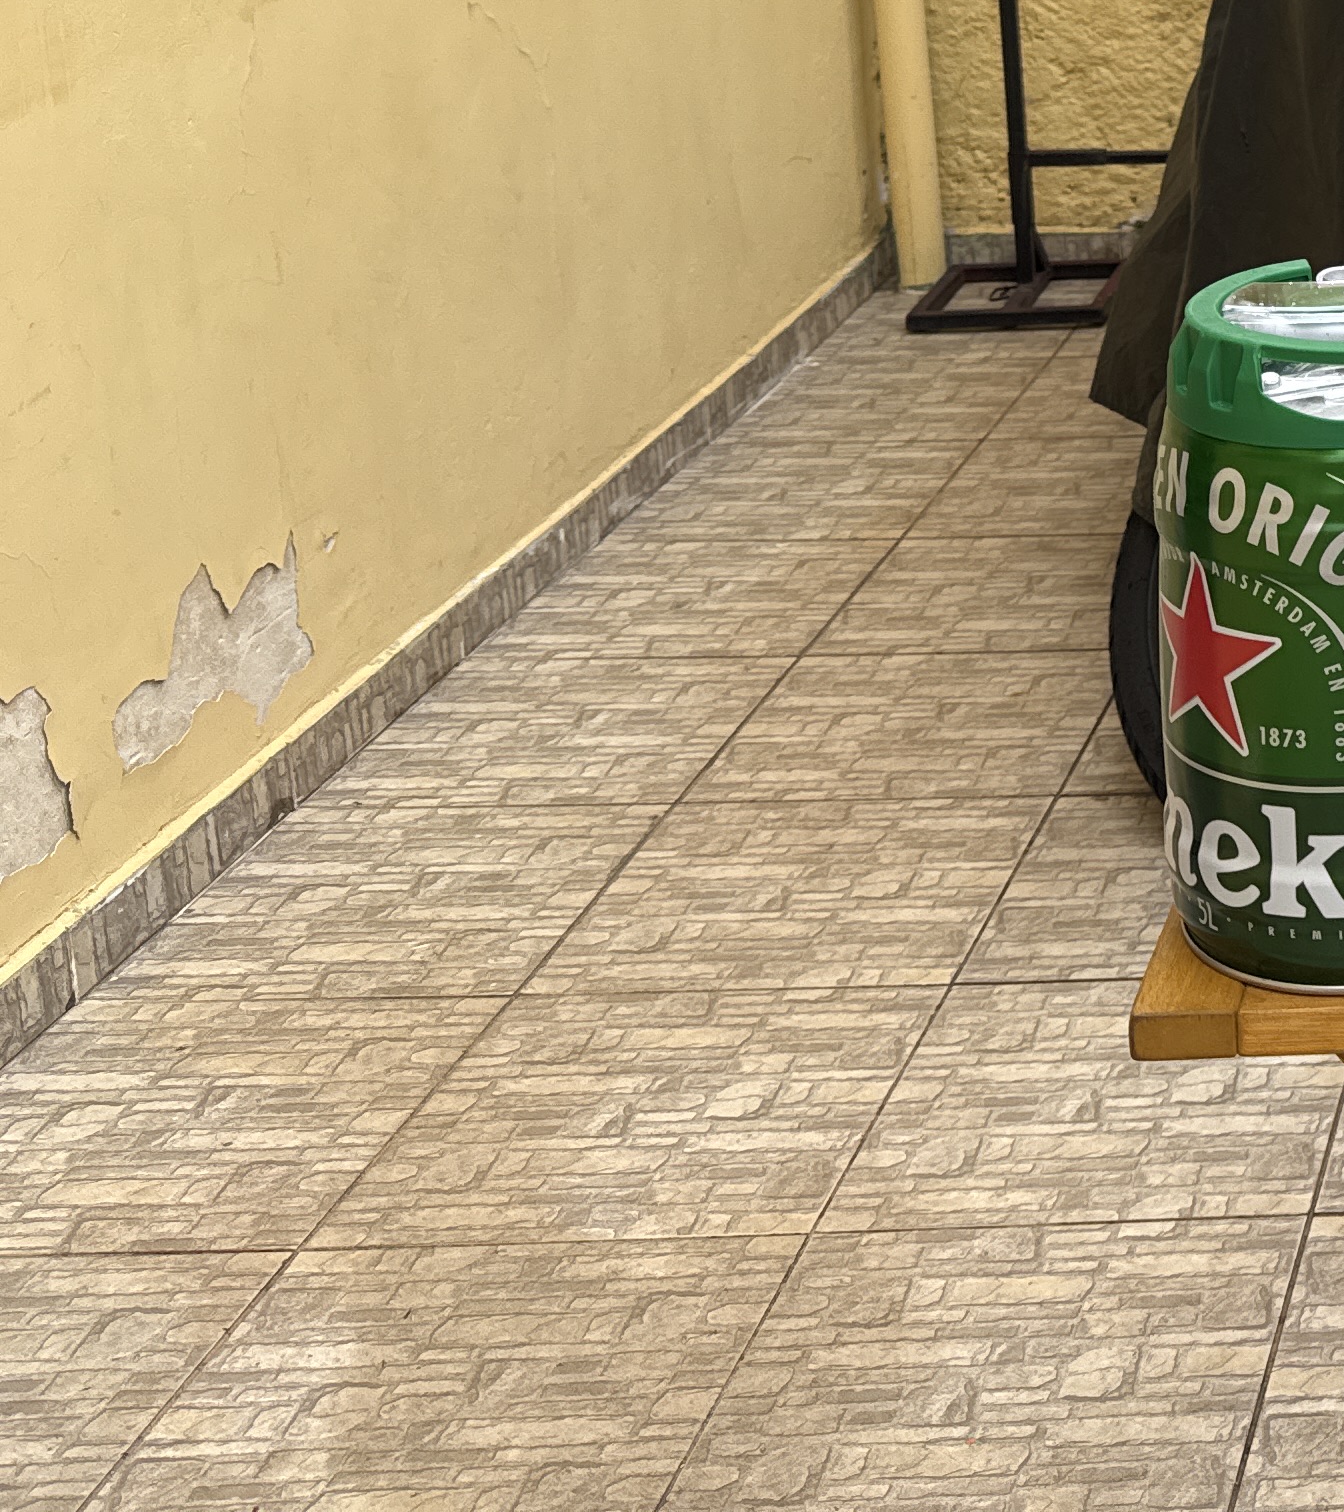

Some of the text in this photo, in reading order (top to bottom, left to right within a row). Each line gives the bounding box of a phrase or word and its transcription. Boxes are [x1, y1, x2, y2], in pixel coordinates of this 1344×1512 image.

[1211, 560, 1331, 653] AMSTERDAM
[1259, 726, 1307, 749] 1873
[1198, 897, 1219, 932] 5L
